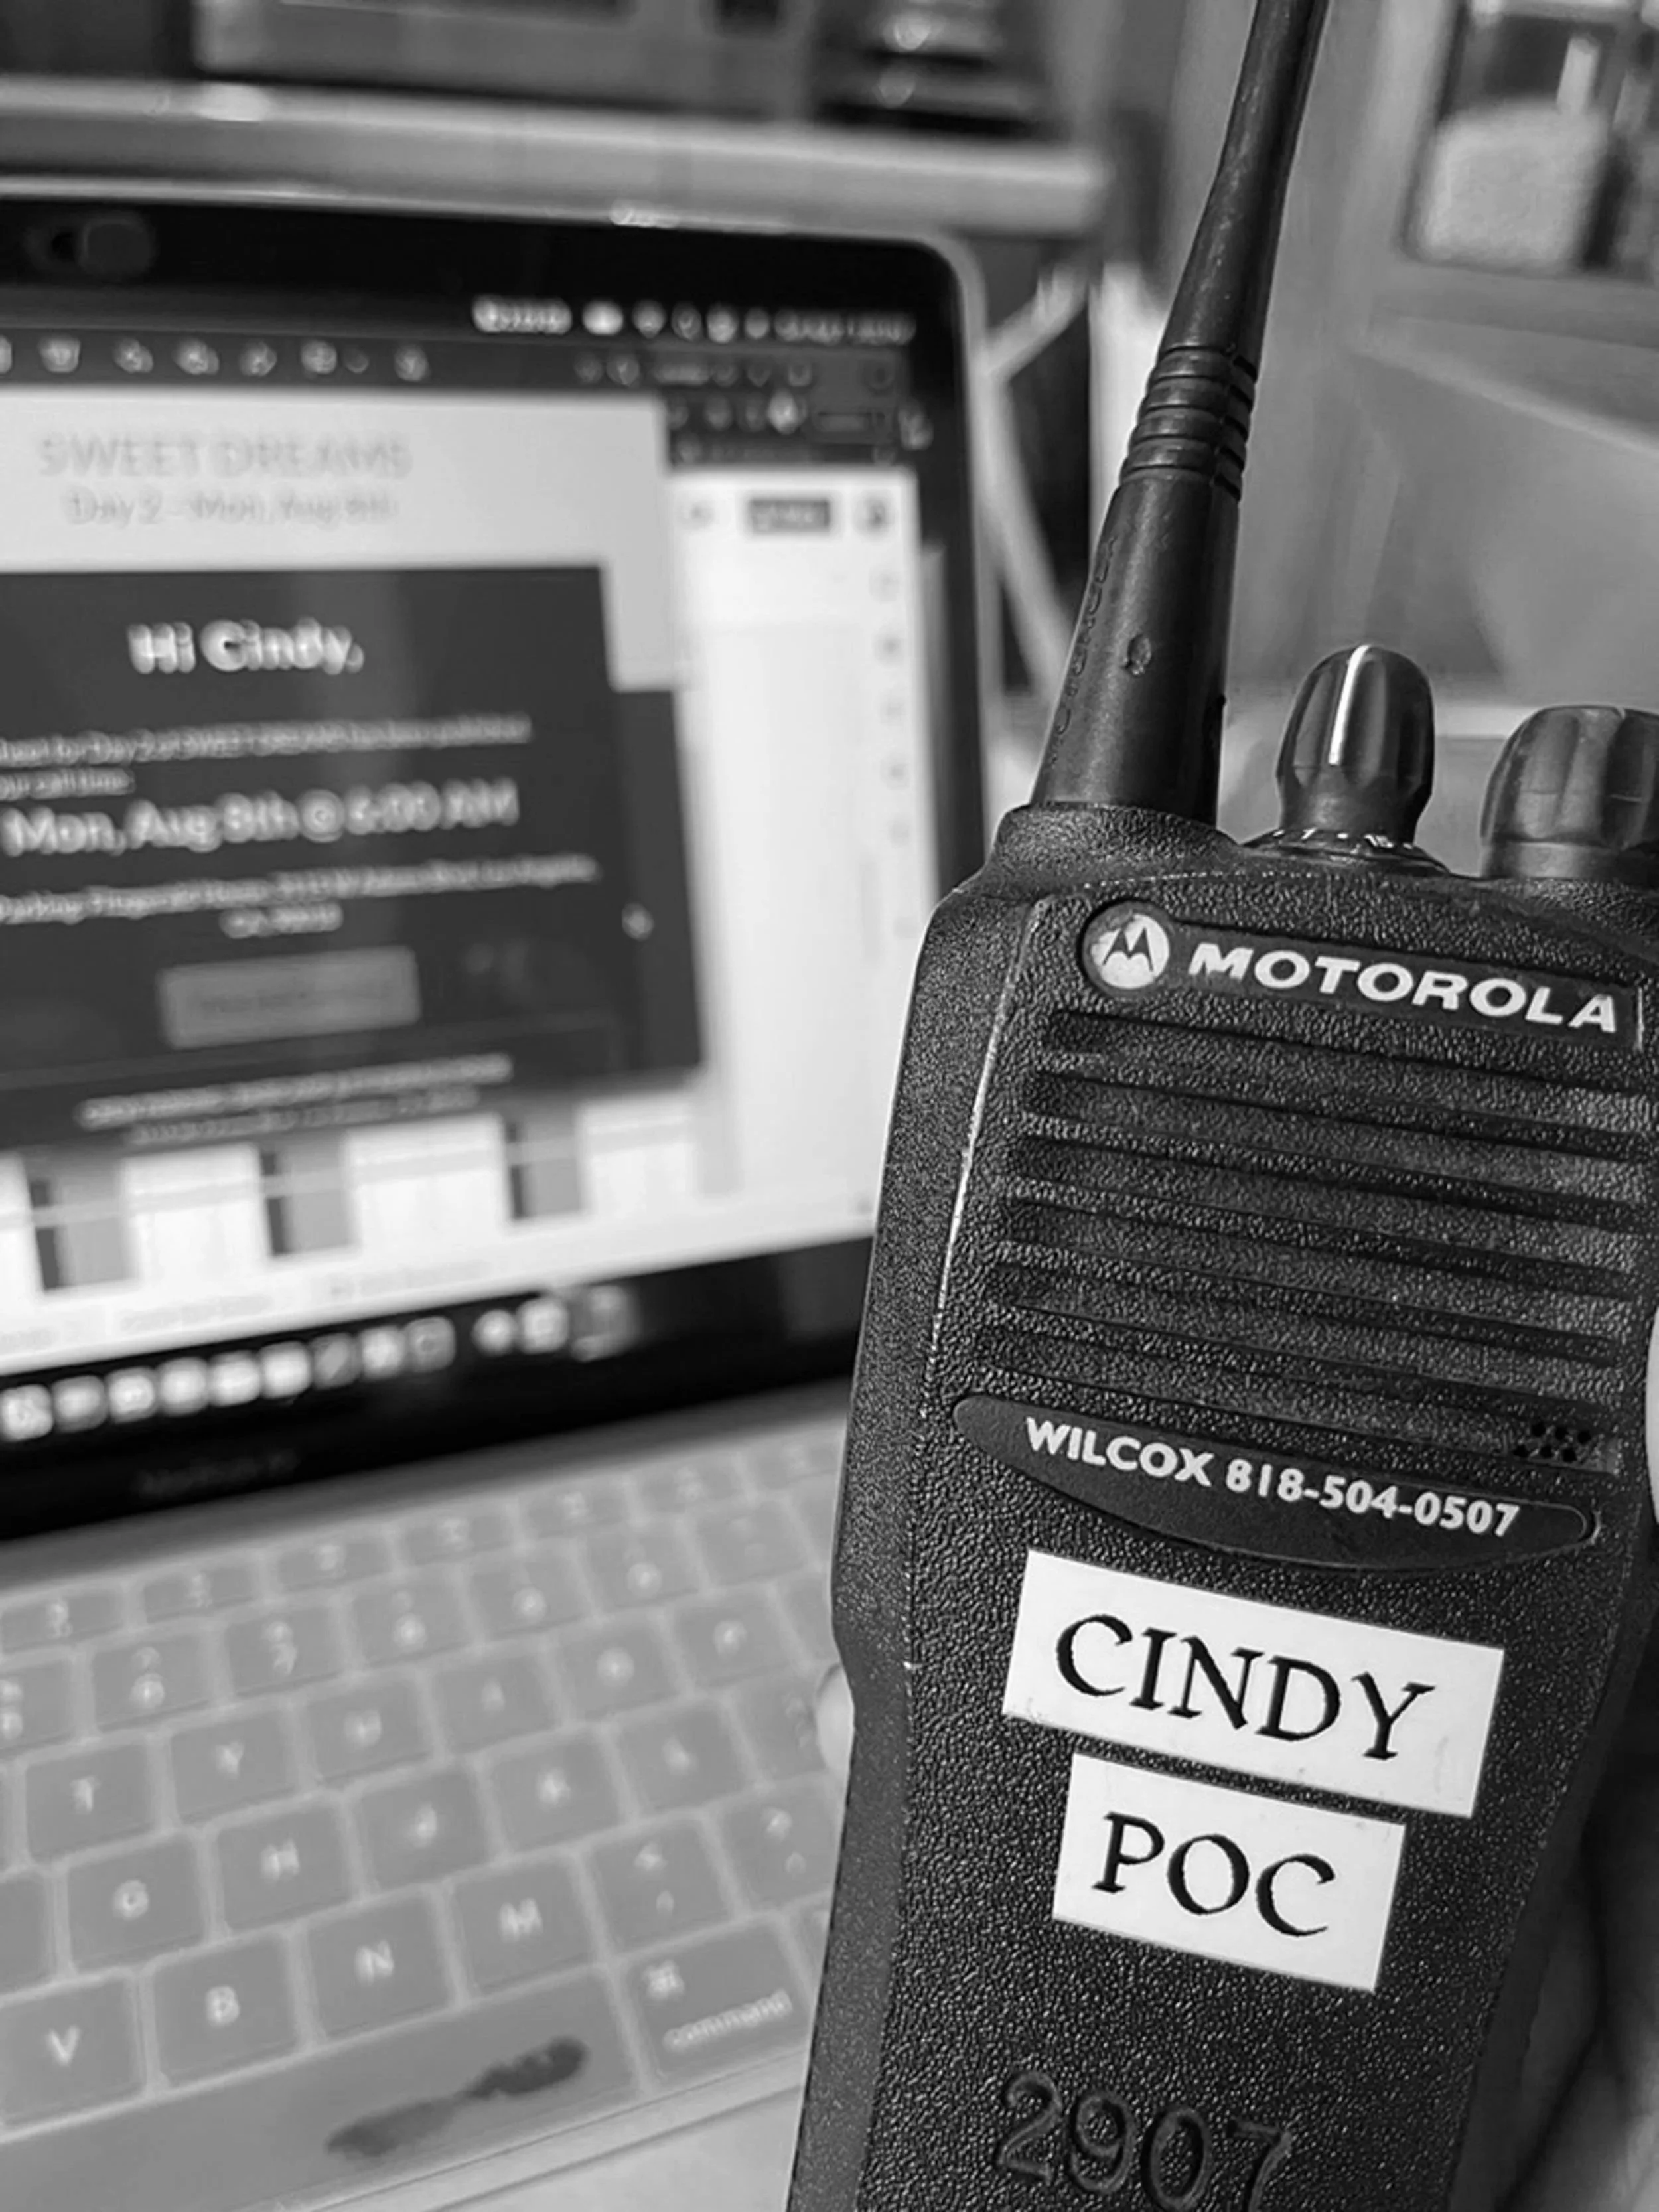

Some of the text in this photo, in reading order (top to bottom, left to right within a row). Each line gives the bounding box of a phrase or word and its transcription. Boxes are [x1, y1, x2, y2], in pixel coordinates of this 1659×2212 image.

[127, 623, 196, 674] Hi
[1188, 942, 1617, 1033] MOTOROLA
[1026, 1416, 1520, 1538] WILCOX 818-504-0507
[1055, 1613, 1436, 1761] CINDY
[1092, 1811, 1336, 1937] POC
[354, 1939, 395, 1986] N
[44, 2026, 81, 2067] V
[999, 2069, 1294, 2212] 2907
